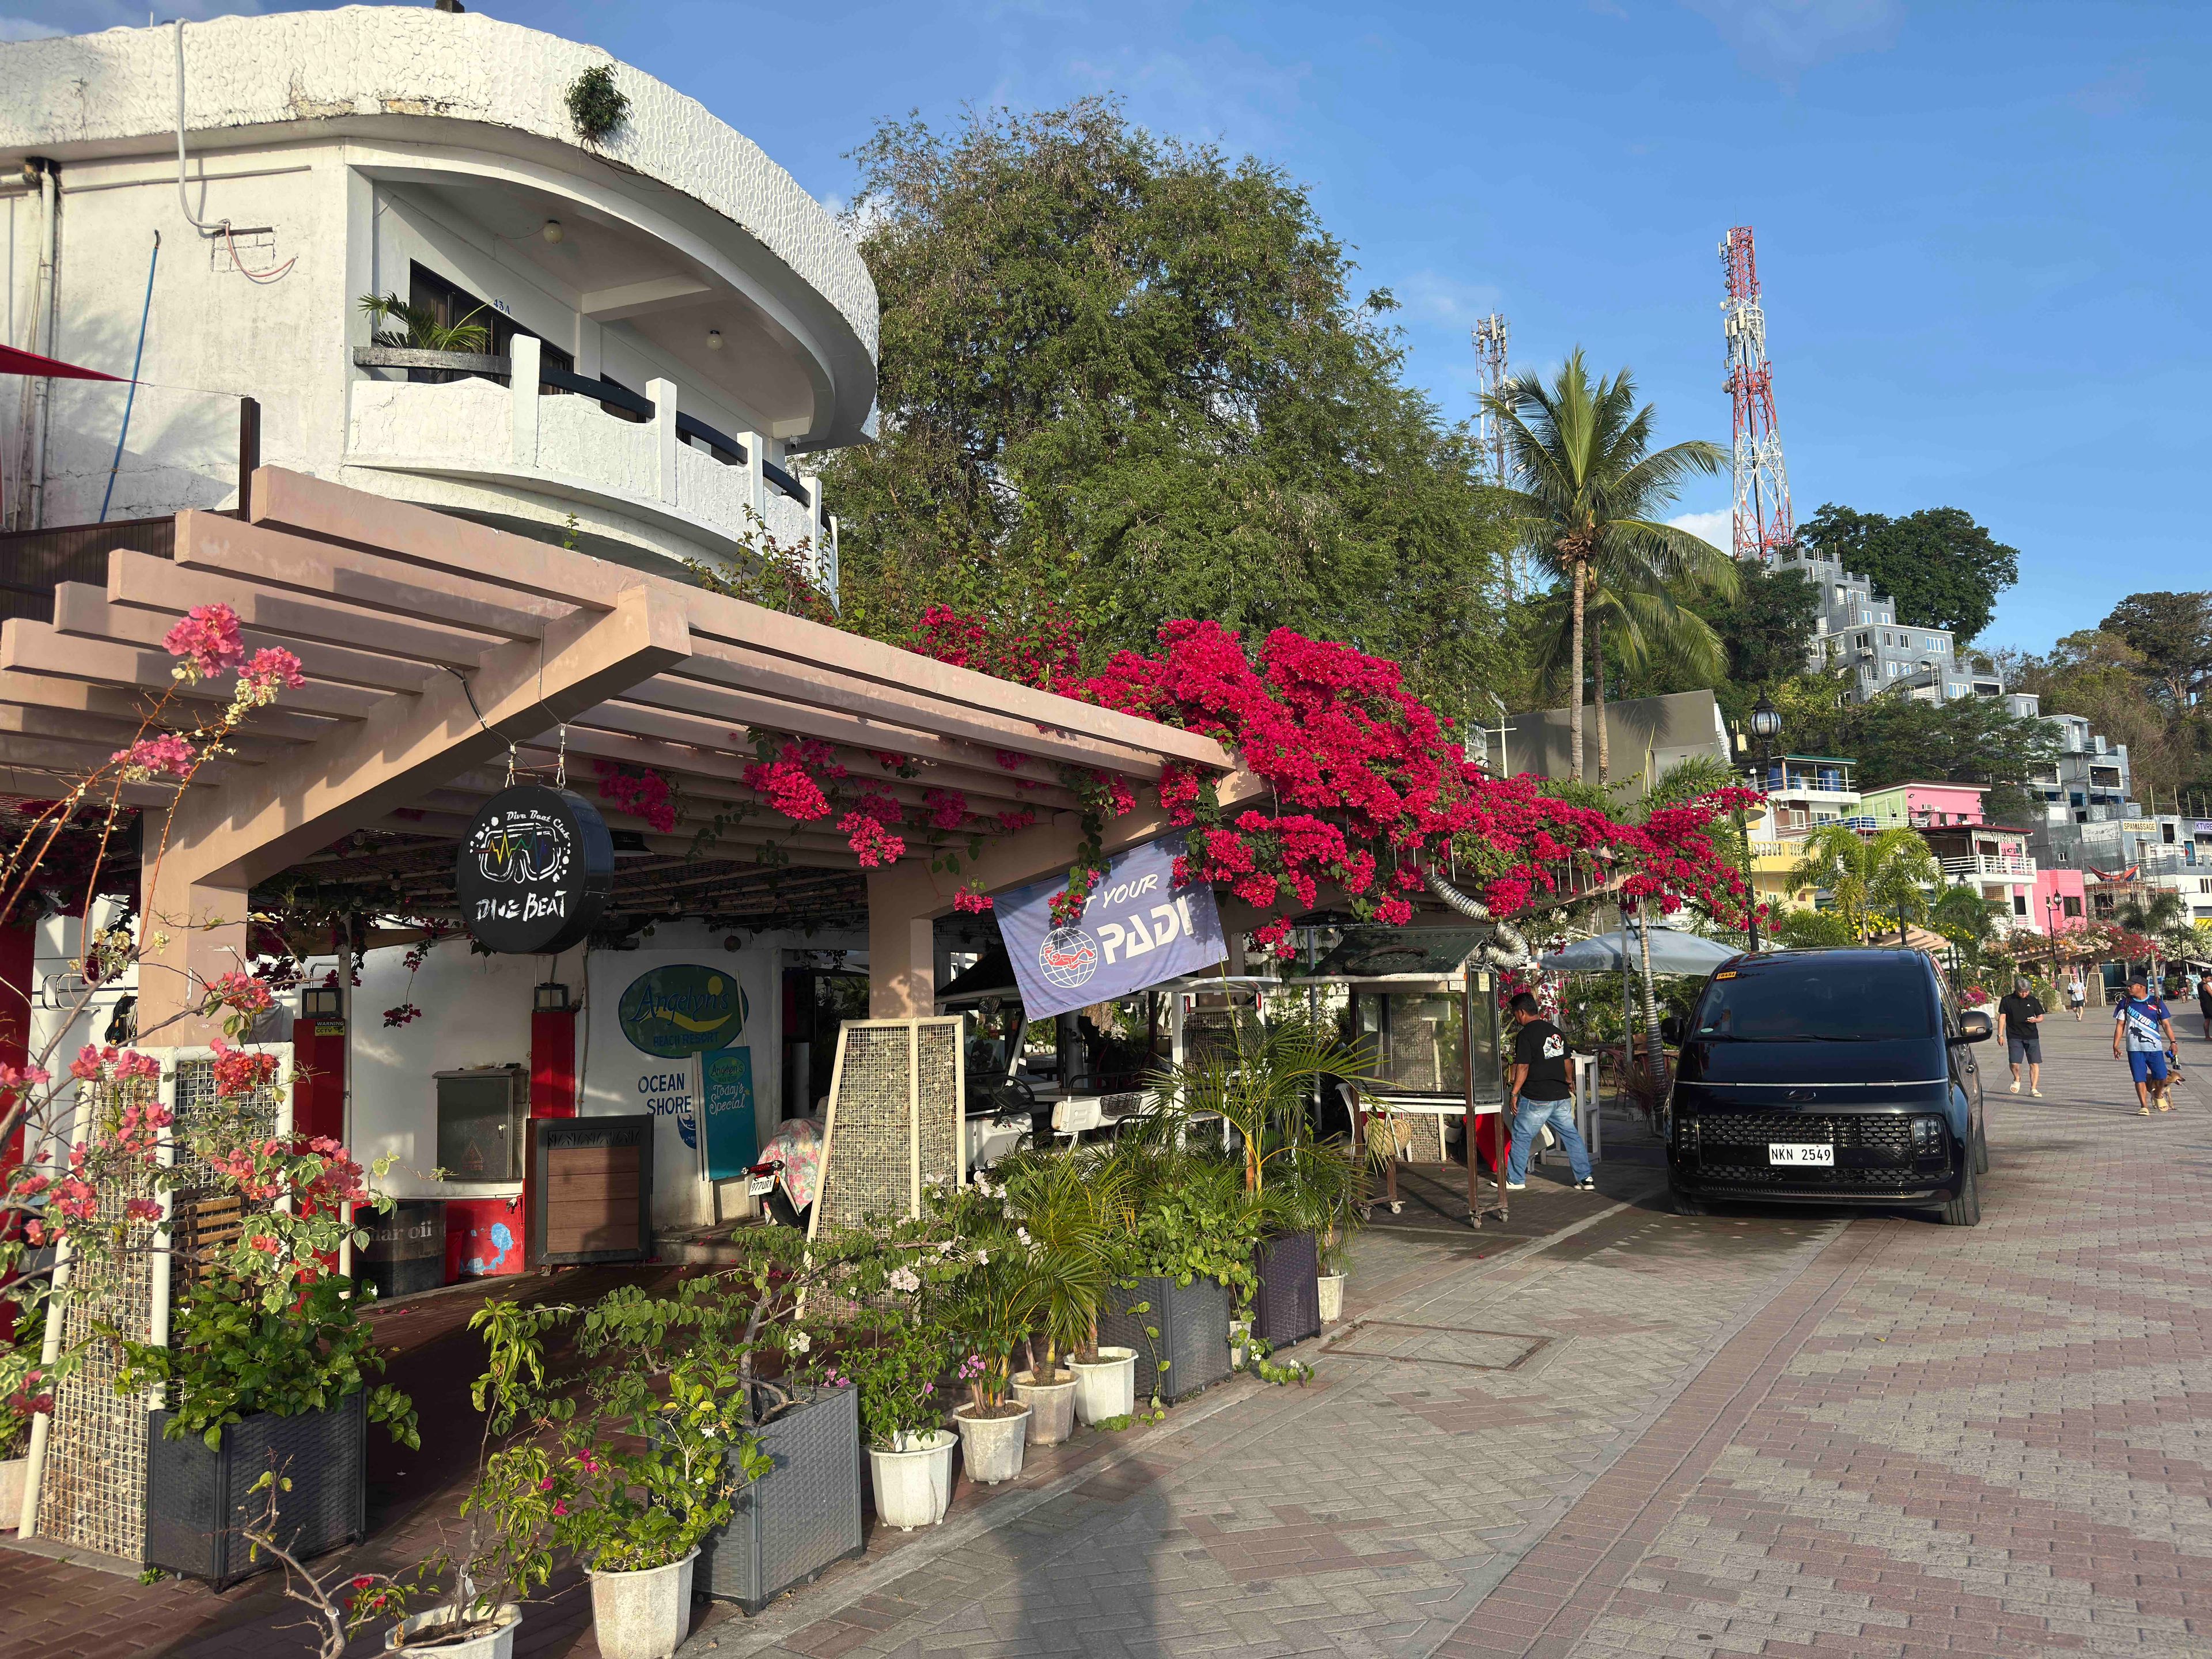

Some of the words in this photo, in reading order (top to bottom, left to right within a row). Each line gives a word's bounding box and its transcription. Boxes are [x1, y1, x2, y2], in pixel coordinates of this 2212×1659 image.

[506, 811, 527, 821] Dive
[529, 809, 551, 823] Beat
[552, 818, 570, 841] Club
[1103, 874, 1158, 909] YOUR
[473, 897, 521, 922] DIVE
[522, 890, 567, 922] BEAT
[1097, 895, 1194, 965] PADI
[628, 983, 729, 1027] Angelyn's
[654, 1035, 680, 1048] BEACH
[680, 1031, 719, 1046] RESORT
[638, 1073, 684, 1093] OCEAN
[713, 1082, 744, 1099] Today's
[646, 1096, 692, 1115] SHORE
[709, 1094, 745, 1116] Special
[1771, 1149, 1793, 1160] NKN
[1801, 1149, 1831, 1161] 2549
